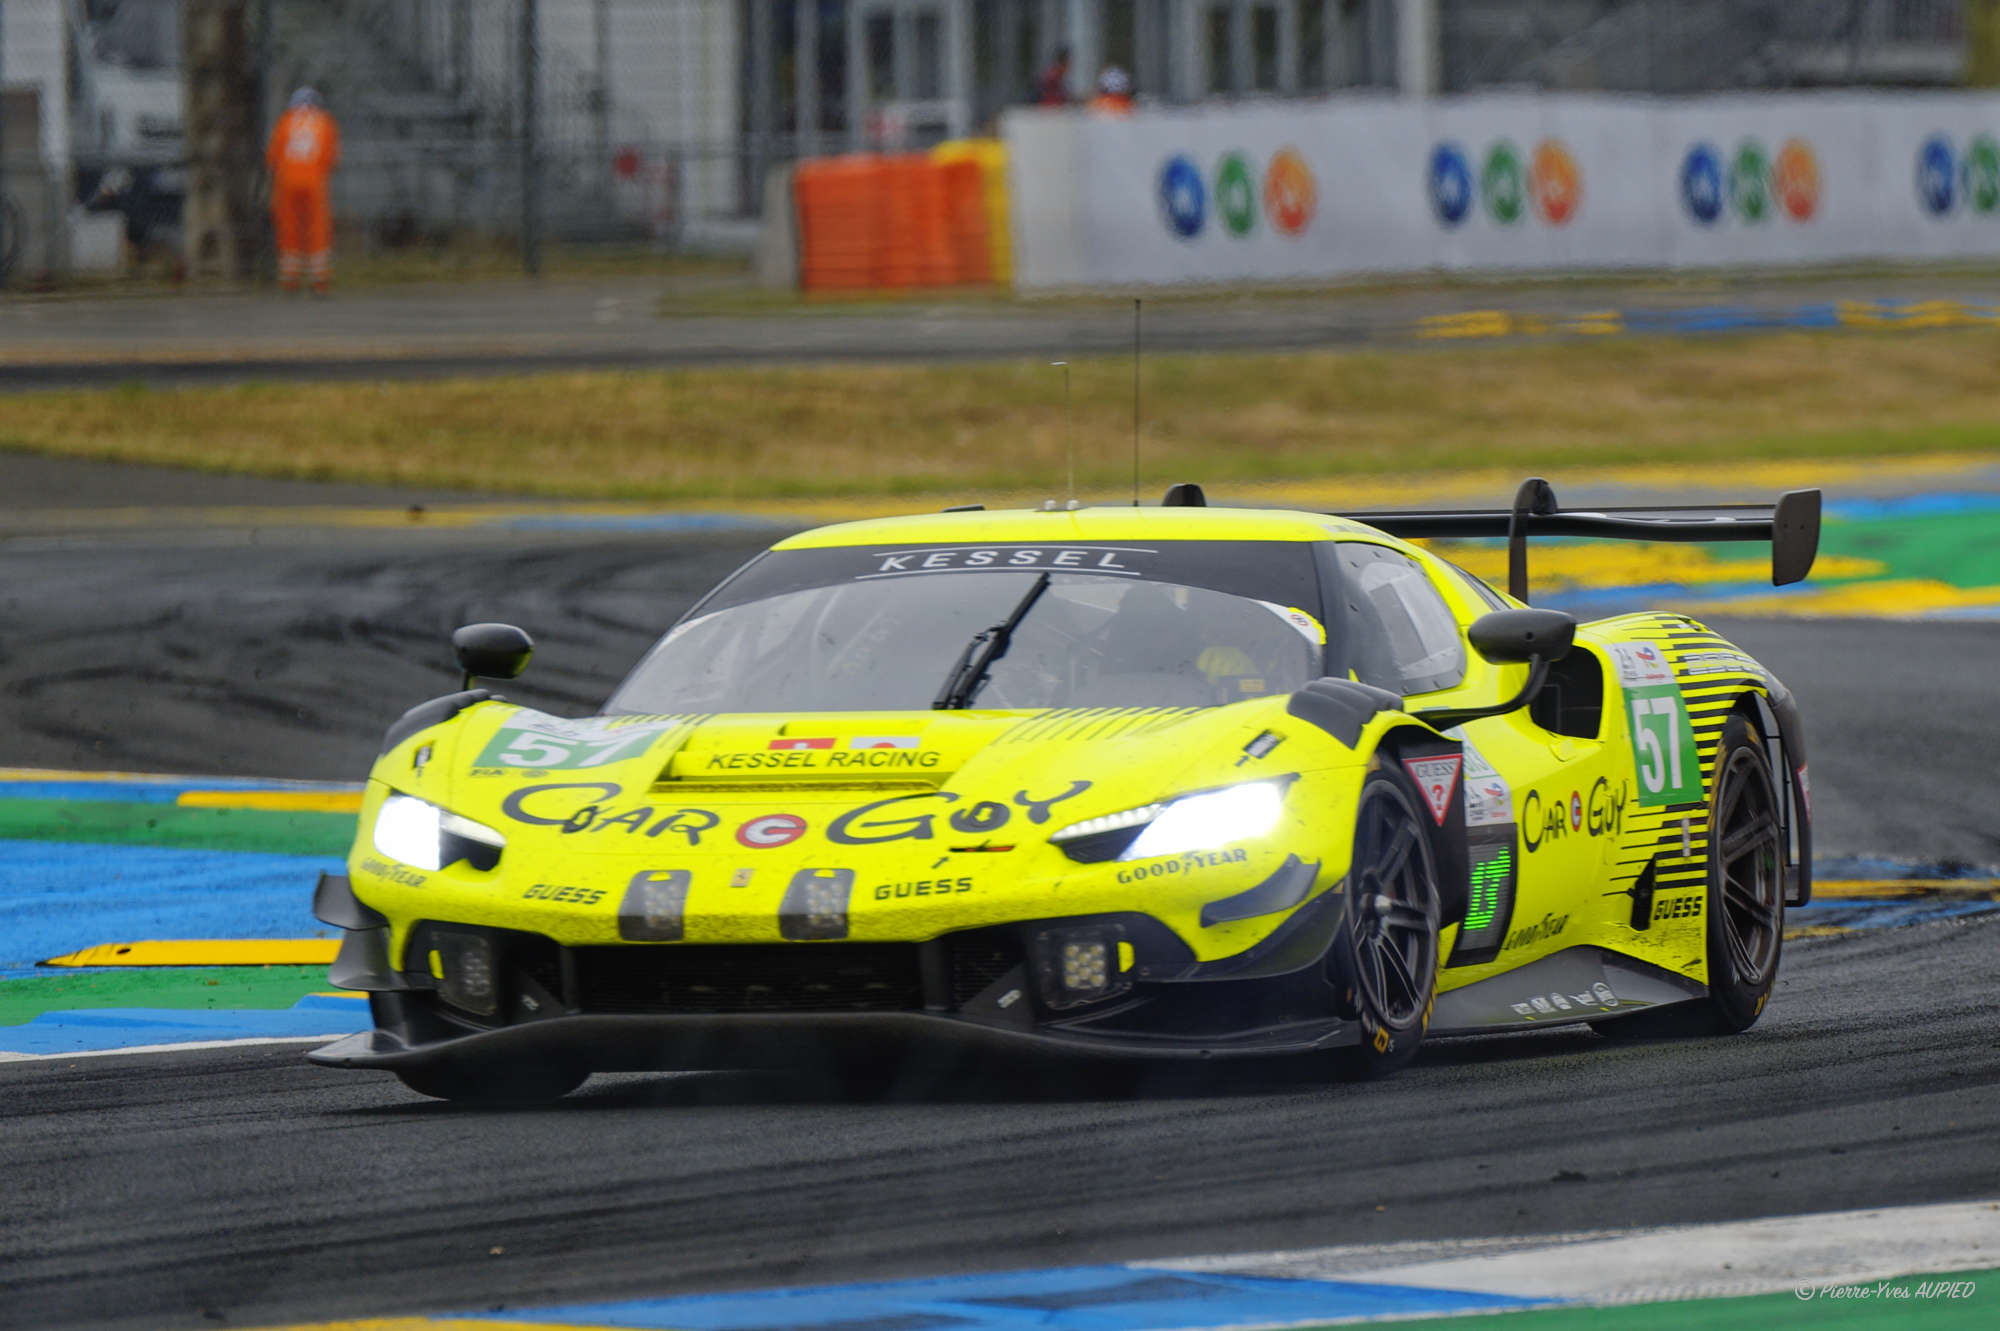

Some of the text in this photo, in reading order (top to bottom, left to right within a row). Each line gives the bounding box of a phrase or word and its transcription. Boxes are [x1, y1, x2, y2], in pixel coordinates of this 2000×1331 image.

[879, 551, 1125, 571] KESSEL
[498, 729, 655, 767] 57
[1631, 696, 1683, 793] 57
[706, 751, 941, 769] KESSEL RACING
[523, 884, 607, 905] GUESS
[875, 876, 972, 900] GUESS
[1654, 896, 1703, 921] GUESS
